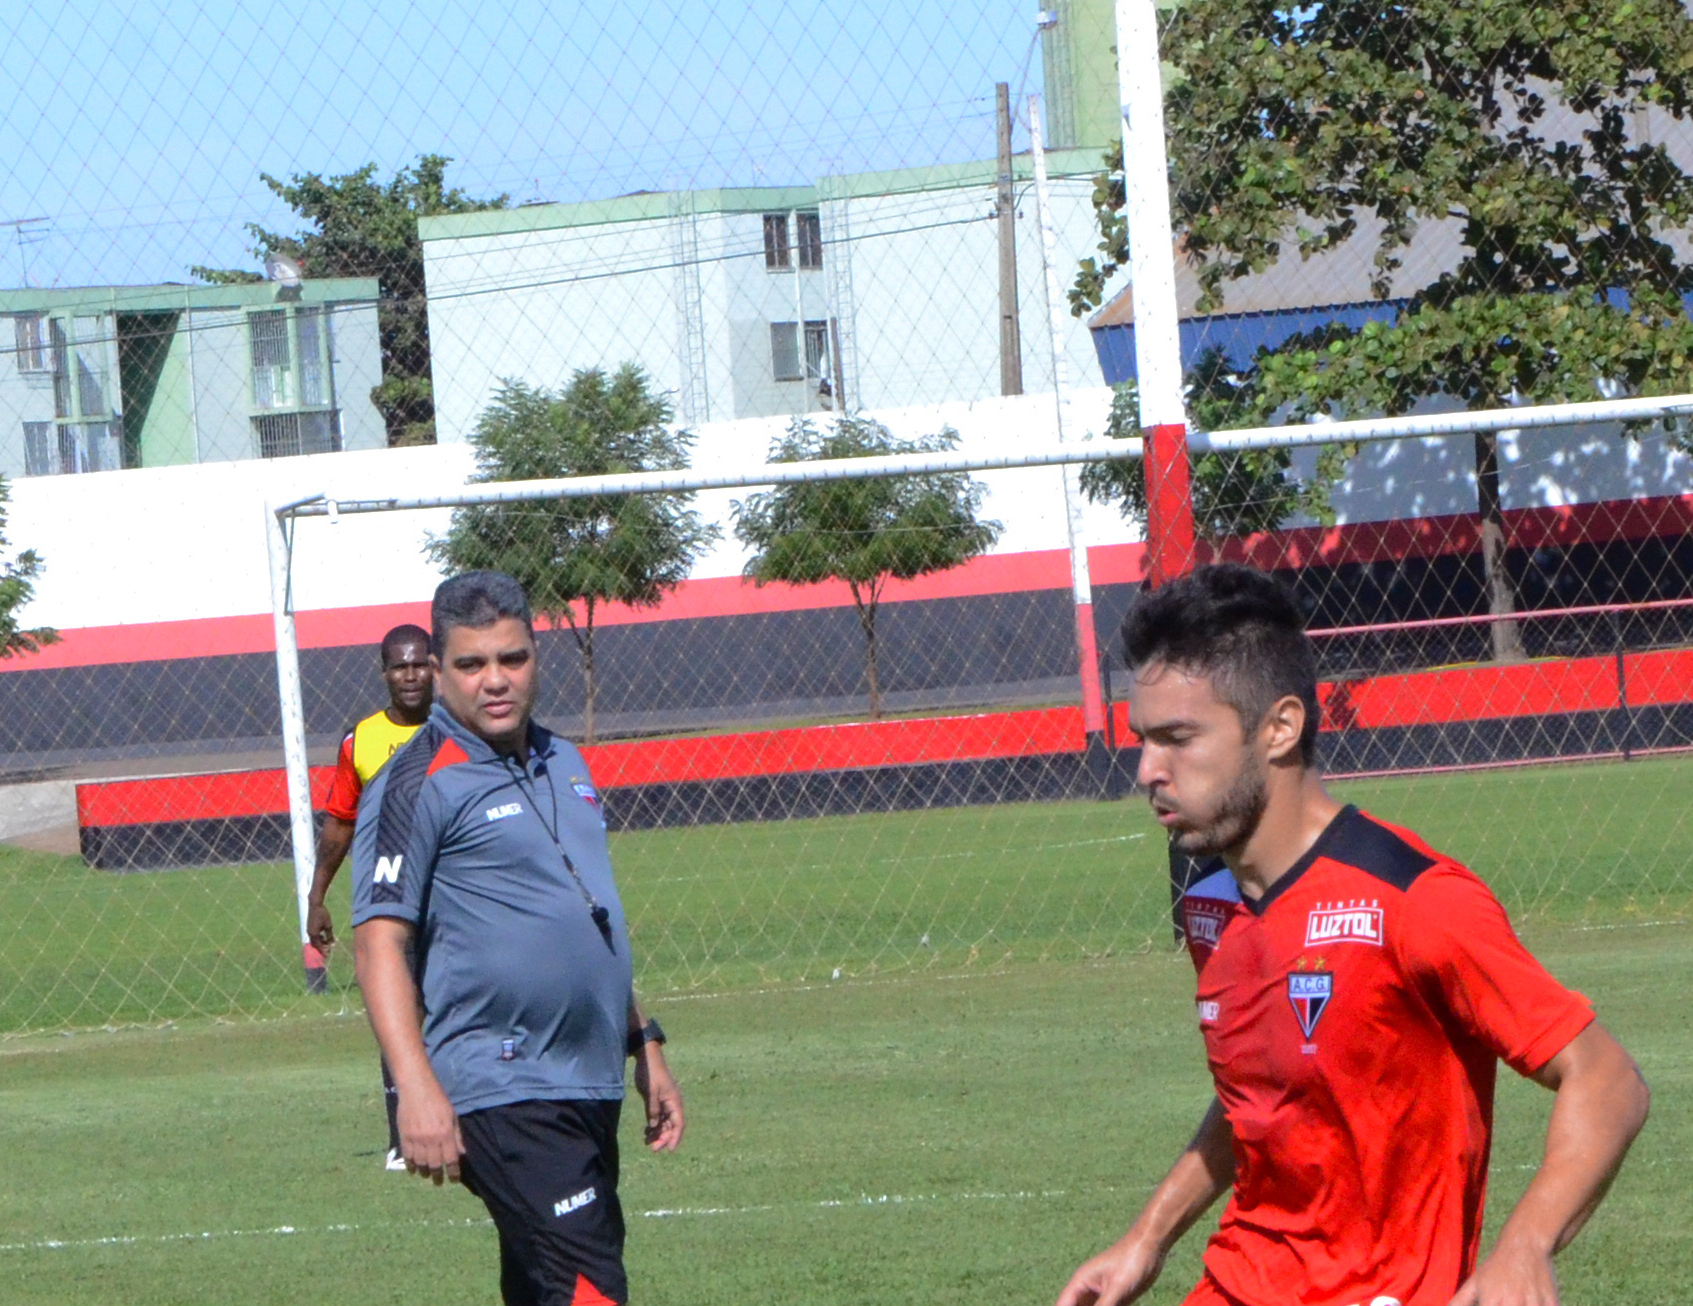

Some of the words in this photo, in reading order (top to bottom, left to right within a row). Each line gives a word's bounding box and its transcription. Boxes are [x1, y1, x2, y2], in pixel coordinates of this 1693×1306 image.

[373, 854, 403, 883] N
[1316, 899, 1378, 911] TINTAS
[1310, 912, 1377, 940] LUZTOL
